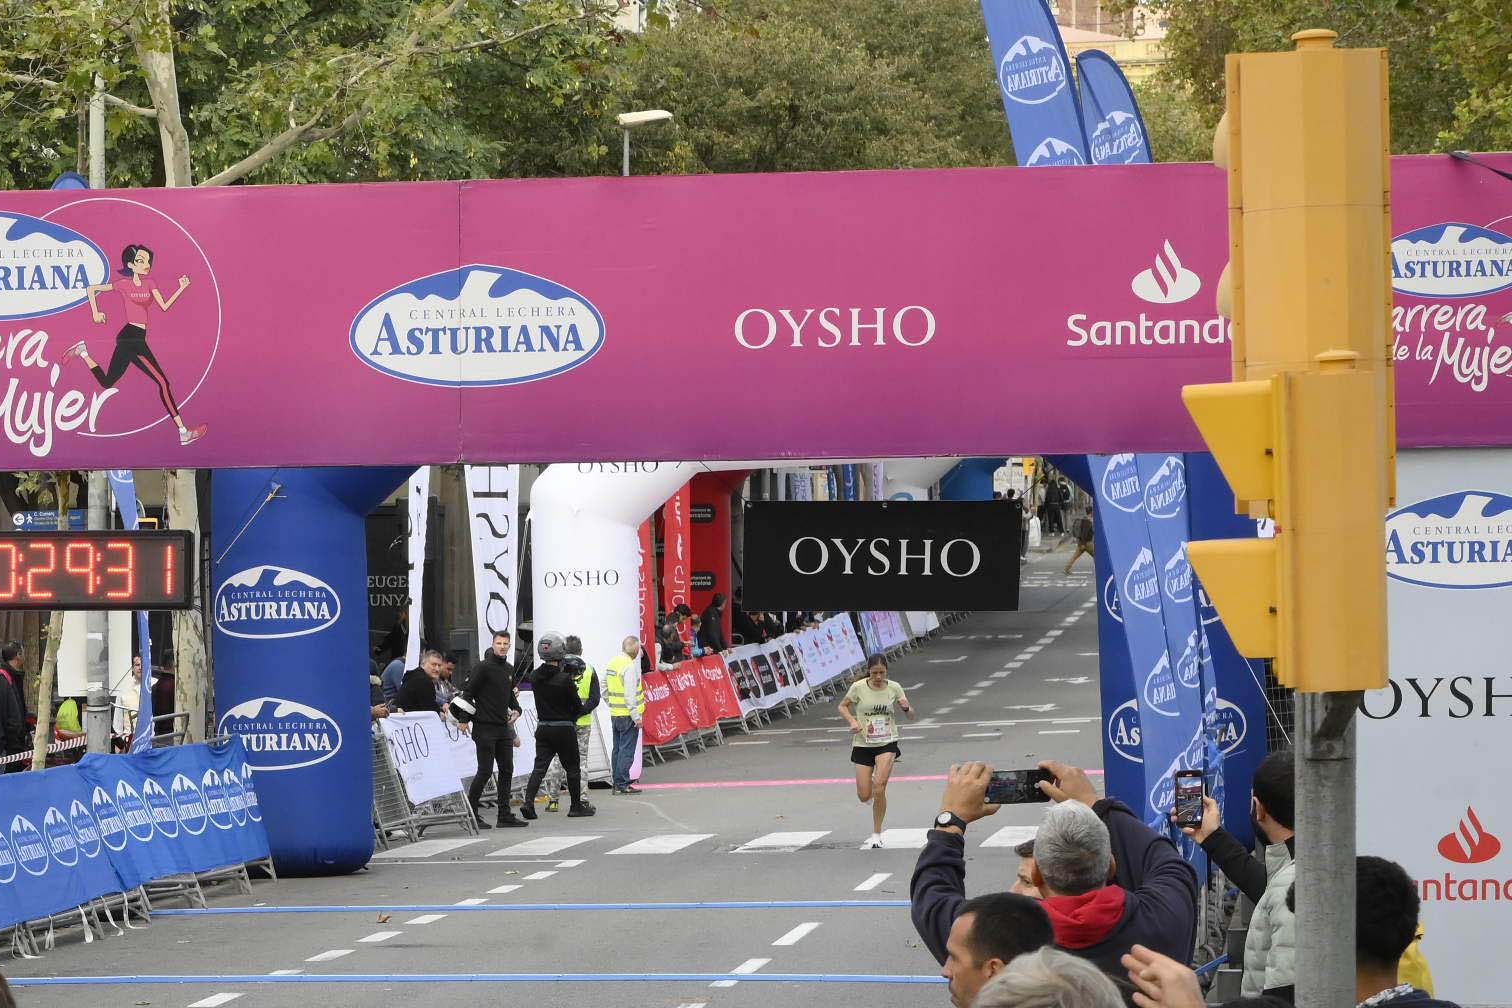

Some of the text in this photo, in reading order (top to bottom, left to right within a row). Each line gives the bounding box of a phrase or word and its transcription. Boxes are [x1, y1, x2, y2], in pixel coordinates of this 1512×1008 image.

[13, 248, 85, 259] LECHERA
[409, 306, 577, 320] CENTRAL LECHERA
[734, 305, 937, 349] OYSHO
[1392, 303, 1488, 333] arrera
[370, 312, 586, 357] ASTURIANA
[1066, 313, 1233, 347] Santand
[1415, 334, 1434, 361] la
[1428, 328, 1512, 393] Muje
[1412, 525, 1480, 536] CENTRAL
[788, 536, 982, 577] OYSHO
[544, 568, 620, 589] OYSHO
[218, 594, 332, 623] ASTURIANA
[231, 590, 327, 600] CENTRAL LECHERA
[1359, 676, 1512, 721] OYSH
[233, 722, 328, 731] CENTRAL LECHERA
